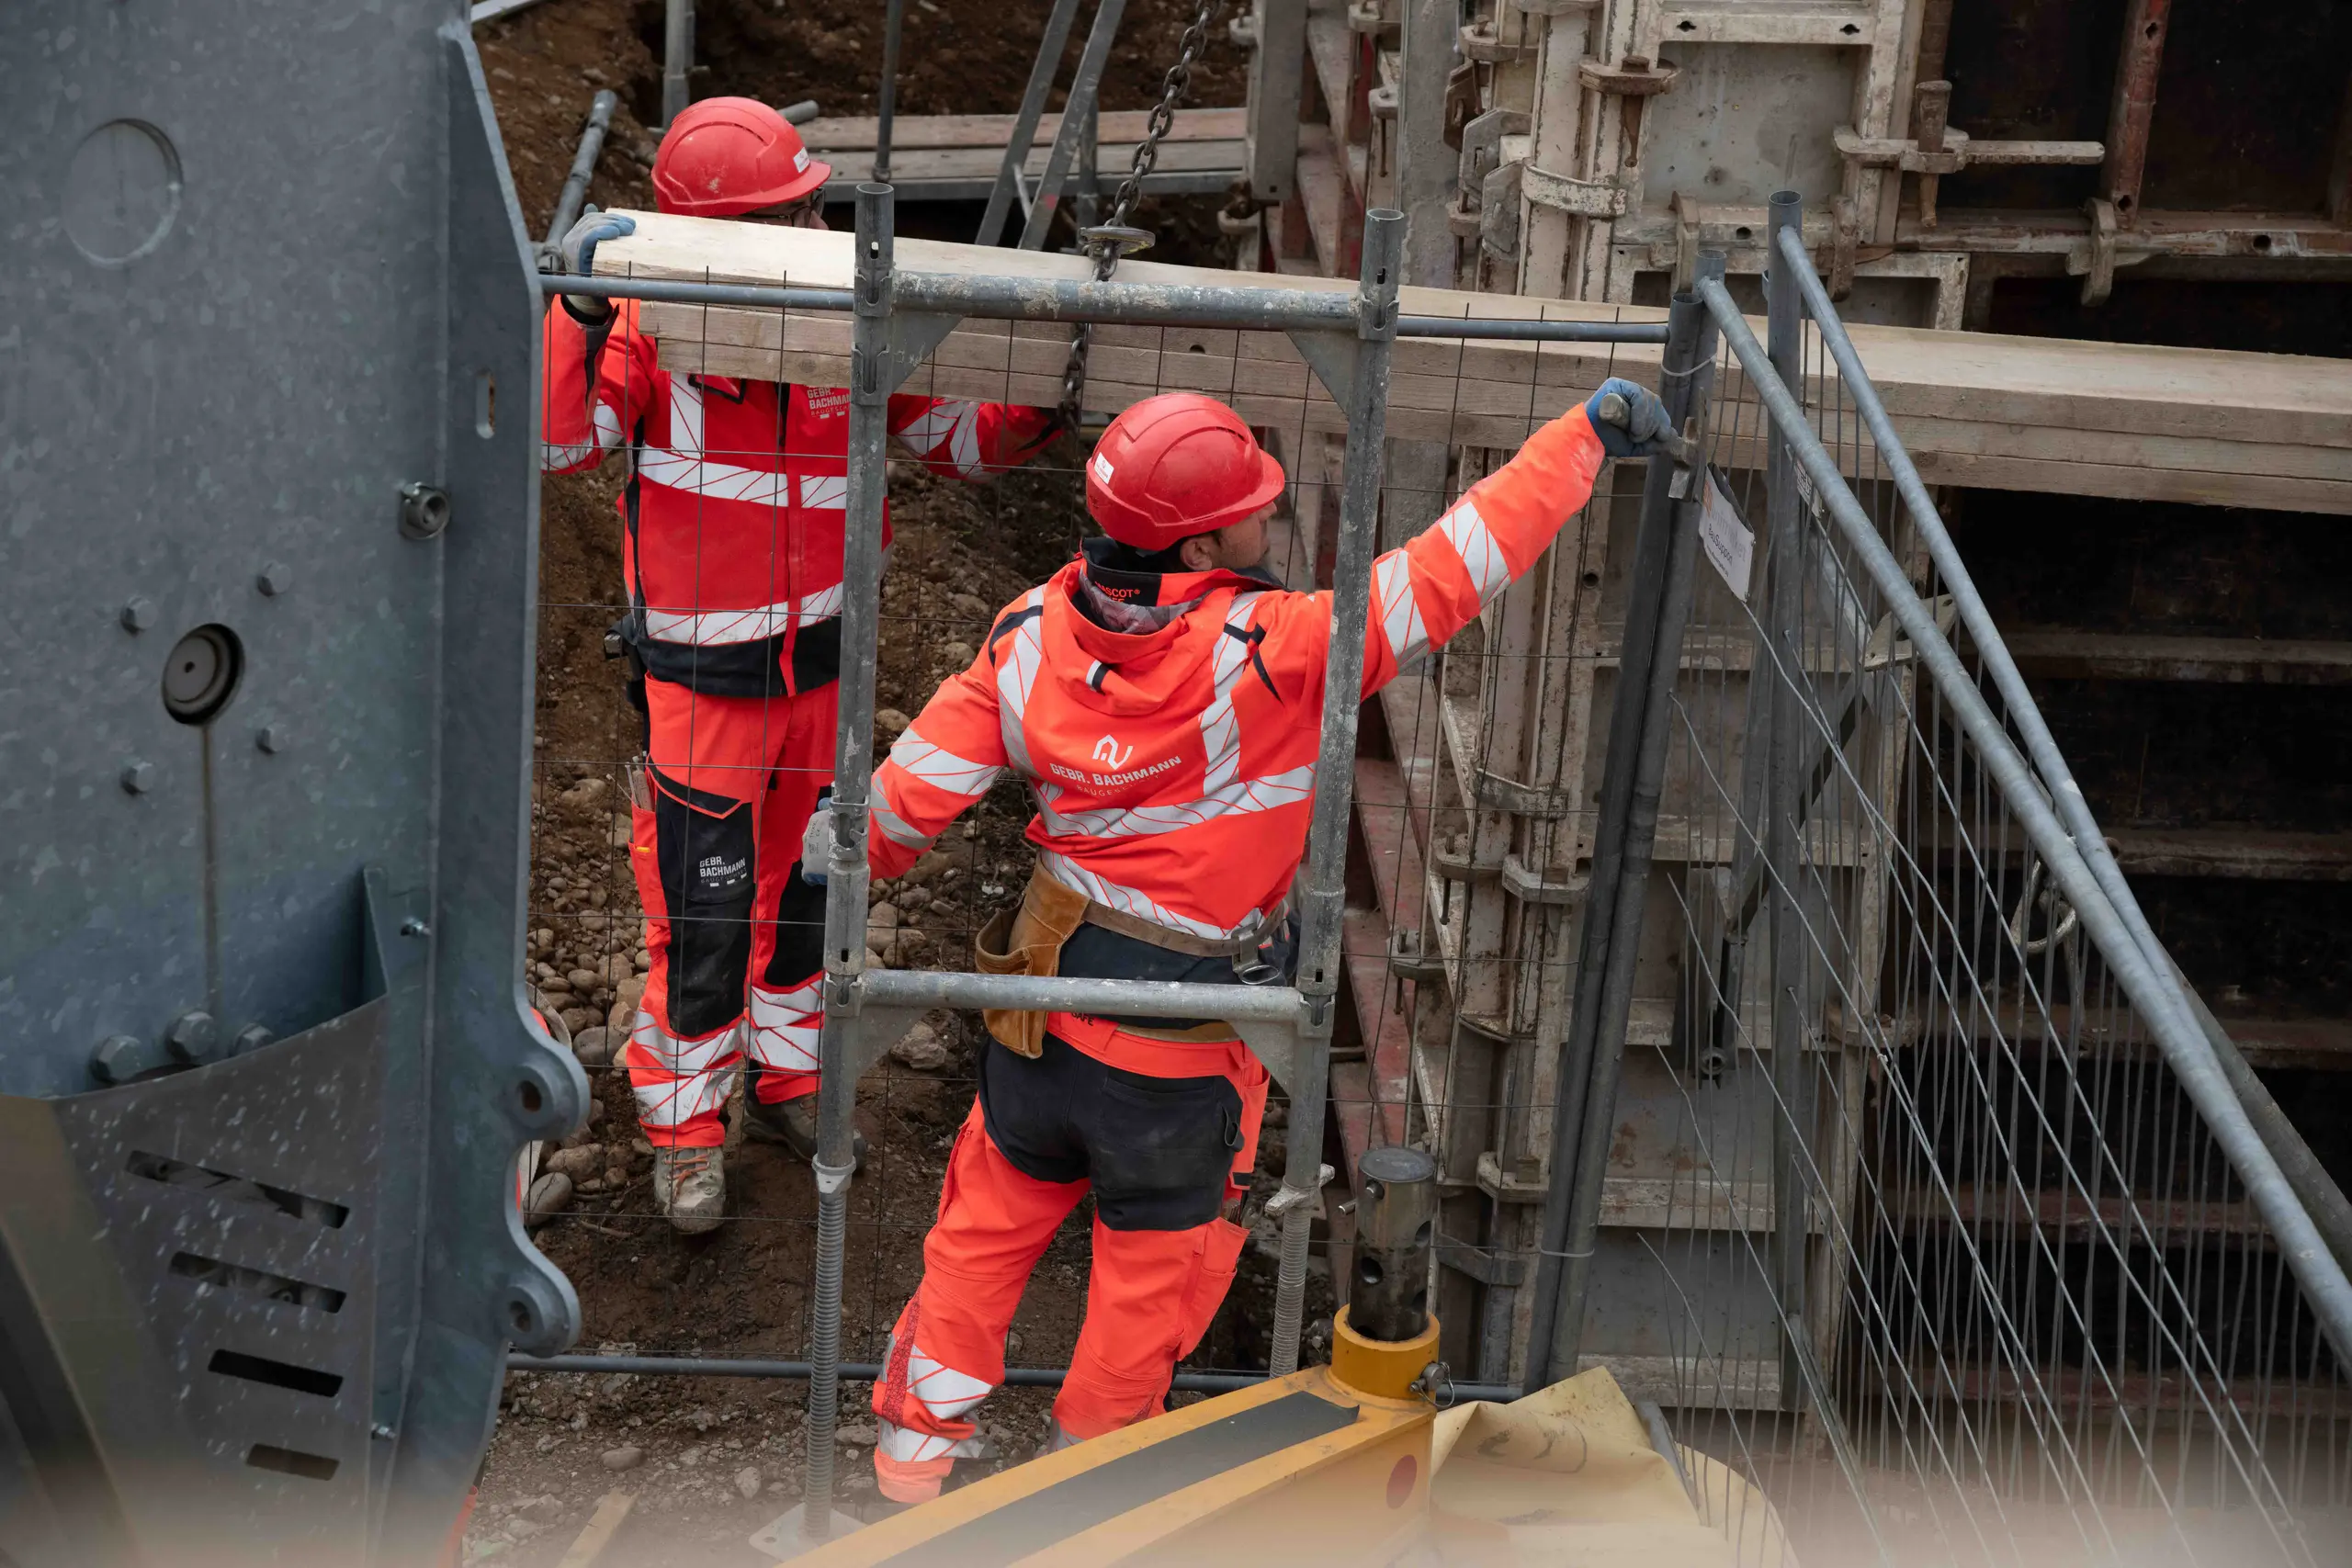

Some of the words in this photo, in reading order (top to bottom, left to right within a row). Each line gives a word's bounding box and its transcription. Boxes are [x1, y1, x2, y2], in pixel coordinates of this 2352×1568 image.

[807, 387, 834, 399] GEBR.
[1048, 762, 1091, 784] GEBR.
[1091, 755, 1182, 787] BACHMANN
[699, 855, 726, 868] GEBR.
[699, 857, 746, 877] BACHMANN
